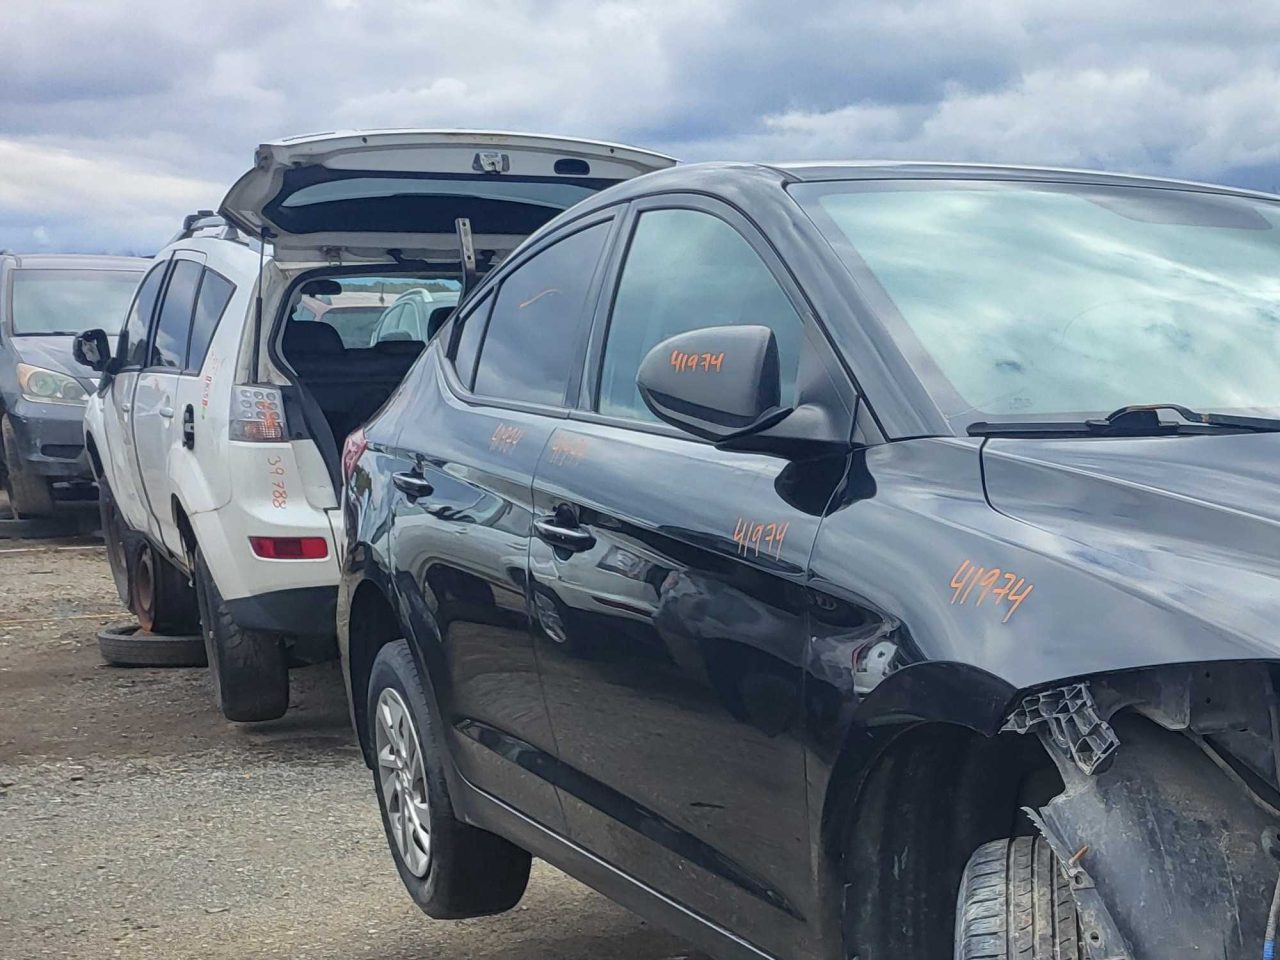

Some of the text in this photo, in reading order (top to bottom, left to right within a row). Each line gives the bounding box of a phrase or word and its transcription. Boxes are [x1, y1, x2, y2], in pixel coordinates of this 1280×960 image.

[671, 350, 724, 373] 41974
[732, 518, 789, 561] 41974
[950, 559, 1033, 623] 41974
